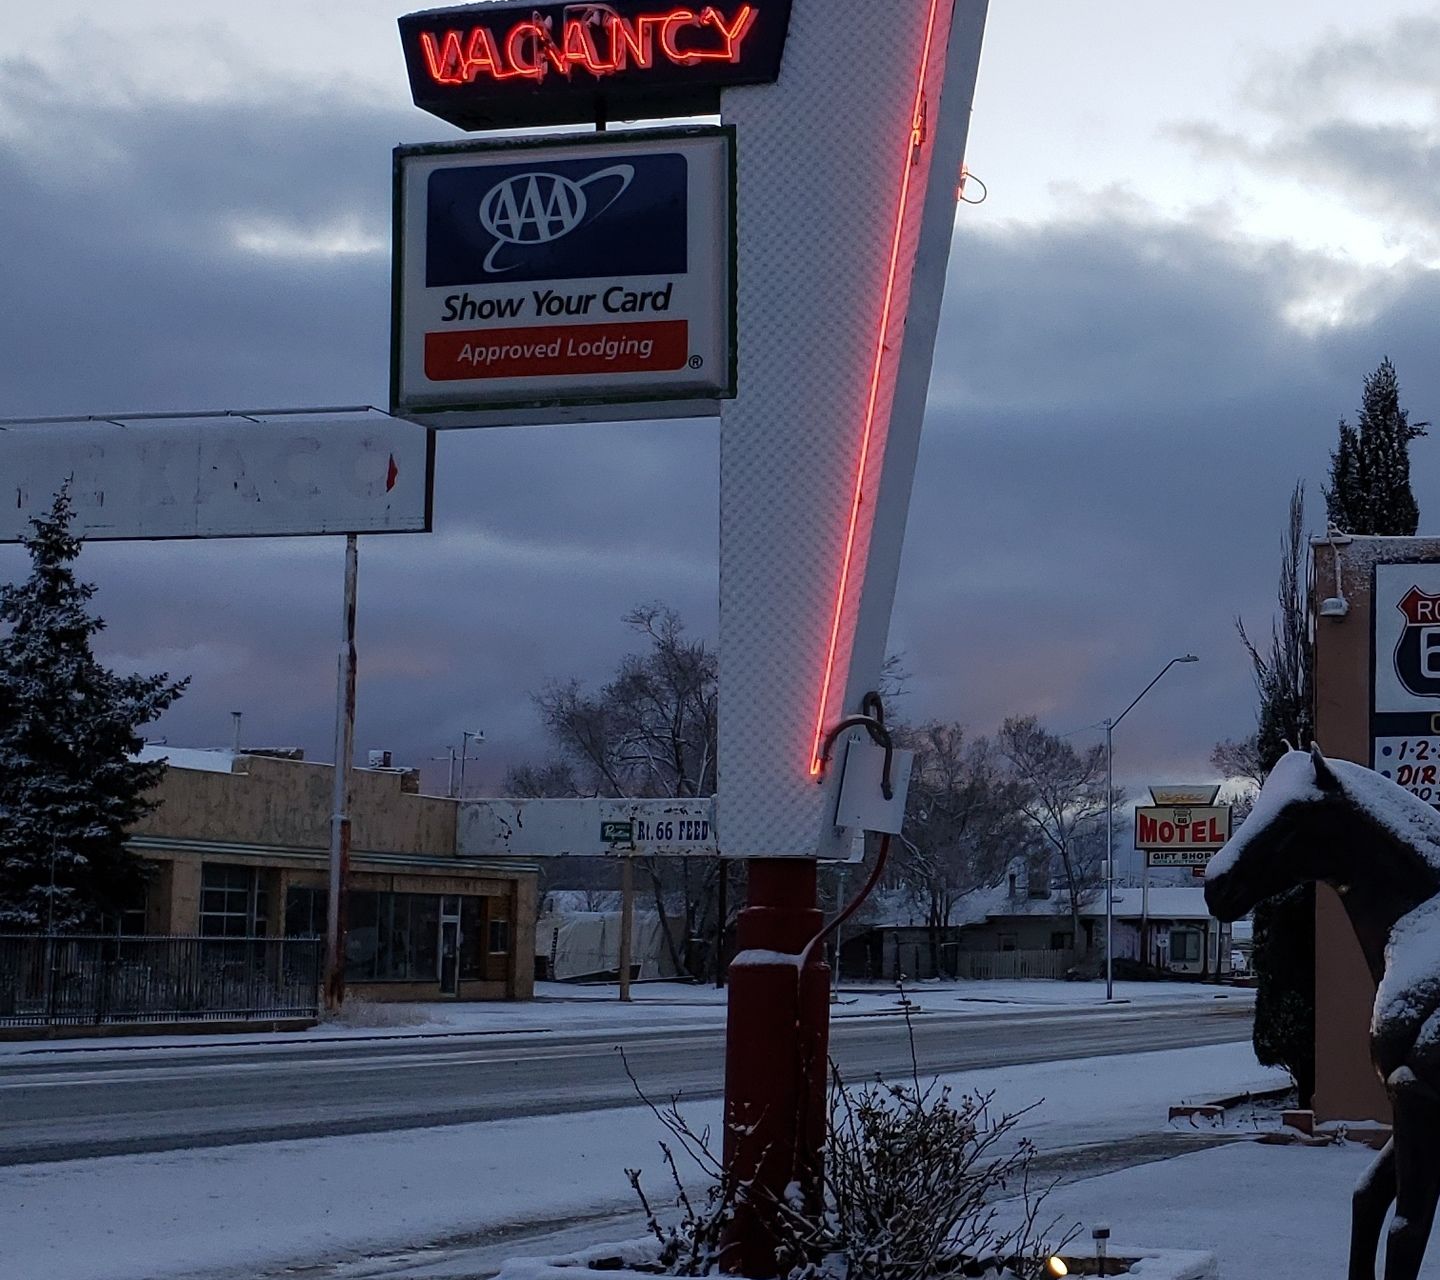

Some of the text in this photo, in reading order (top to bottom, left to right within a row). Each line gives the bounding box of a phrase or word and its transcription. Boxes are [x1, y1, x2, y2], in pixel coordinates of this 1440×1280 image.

[421, 2, 758, 85] VACANCY
[493, 176, 574, 241] AAA
[441, 282, 672, 321] Show Your Card
[457, 335, 654, 366] Approved Lodging
[679, 820, 709, 841] FEED
[1139, 813, 1225, 843] MOTEL
[1153, 852, 1211, 860] GIFT SHOP
